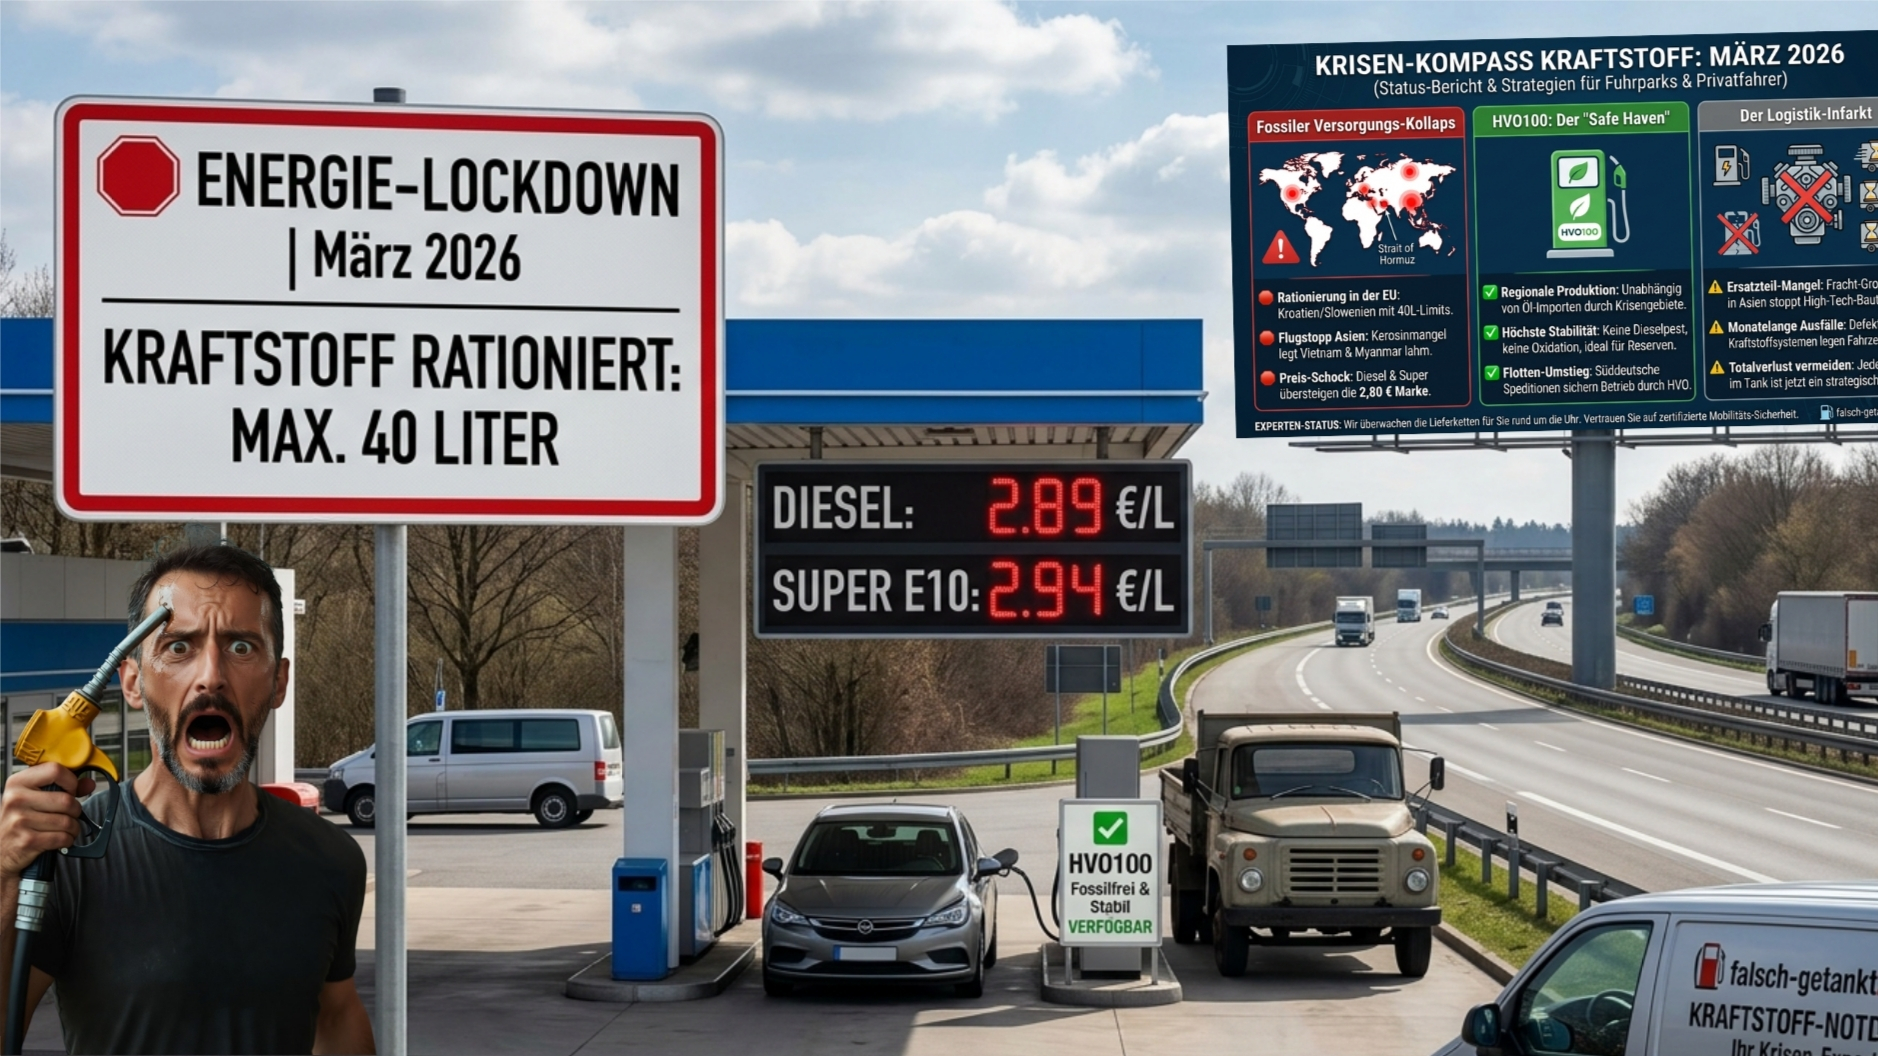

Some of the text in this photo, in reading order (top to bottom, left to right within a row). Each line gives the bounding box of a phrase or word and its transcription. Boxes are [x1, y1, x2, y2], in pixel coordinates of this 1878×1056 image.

[1316, 41, 1844, 75] KRISEN-KOMPASS KRAFTSTOFF: MÄRZ 2026
[1374, 71, 1787, 98] (Status-Bericht & Strategien für Fuhrparks & Privatfahrer)
[1493, 111, 1669, 127] HVO100: Der "Safe Haven"
[1741, 106, 1872, 124] Der Logistik-Infarkt
[1257, 116, 1455, 134] Fossiler Versorgungs-Kollaps
[199, 152, 678, 217] ENERGIE-LOCKDOWN
[1561, 228, 1598, 236] HVO100
[315, 230, 411, 278] März
[426, 233, 520, 281] 2026
[1378, 243, 1414, 253] Strait of
[1380, 256, 1415, 264] Hormuz
[1502, 283, 1681, 300] Regionale Produktion: Unabhängig
[1728, 279, 1823, 293] Ersatzteil-Mangel:
[1278, 290, 1399, 304] Rationierung in der EU:
[1728, 298, 1736, 308] in
[1739, 297, 1766, 308] Asien
[1770, 297, 1801, 309] stoppt
[1278, 305, 1453, 318] Kroatien/Slowenien mit 40L-Limits.
[1502, 299, 1686, 314] von Öl-Importen durch Krisengebiete.
[1502, 323, 1687, 337] Höchste Stabilität: Keine Dieselpest,
[1728, 318, 1878, 334] Monatelange Ausfälle: Defek
[1279, 329, 1446, 345] Flugstopp Asien: Kerosinmangel
[1729, 337, 1817, 349] Kraftstoffsystemen
[1820, 336, 1845, 348] legen
[1279, 345, 1432, 361] legt Vietnam & Myanmar lahm.
[1503, 340, 1676, 353] keine Oxidation, ideal für Reserven.
[105, 329, 680, 391] KRAFTSTOFF RATIONIERT:
[1729, 361, 1792, 372] Totalverlust
[1795, 359, 1854, 371] vermeiden:
[1280, 370, 1428, 383] Preis-Schock: Diesel & Super
[1503, 364, 1659, 379] Flotten-Umstieg: Süddeutsche
[1504, 379, 1691, 396] Speditionen sichern Betrieb durch HVO.
[1730, 378, 1741, 388] im
[1744, 377, 1768, 388] Tank
[1771, 377, 1782, 388] ist
[1785, 377, 1806, 390] jetzt
[1809, 377, 1822, 387] ein
[1280, 385, 1431, 402] übersteigen die 2,80 € Marke.
[1255, 420, 1341, 431] EXPERTEN-STATUS:
[1344, 420, 1358, 428] Wir
[1360, 419, 1411, 428] überwachen
[1414, 418, 1427, 427] die
[1430, 417, 1479, 427] Lieferketten
[1482, 416, 1494, 425] für
[1497, 416, 1509, 425] Sie
[1512, 415, 1531, 425] rund
[1549, 415, 1562, 424] die
[1564, 414, 1581, 424] Uhr.
[1584, 414, 1625, 423] Vertrauen
[1628, 413, 1641, 422] Sie
[1643, 412, 1657, 422] auf
[1659, 412, 1707, 421] zertifizierte
[1710, 409, 1798, 420] Mobilitäts-Sicherheit.
[1837, 408, 1878, 418] falsch-get
[233, 408, 559, 465] MAX. 40 LITER
[774, 478, 1174, 535] DIESEL: 2.89 €/L
[773, 561, 1174, 618] SUPER E10: 2.94 €/L
[1070, 853, 1152, 874] HVO100
[1071, 882, 1149, 895] Fossilfrei &
[1091, 900, 1130, 913] Stabil
